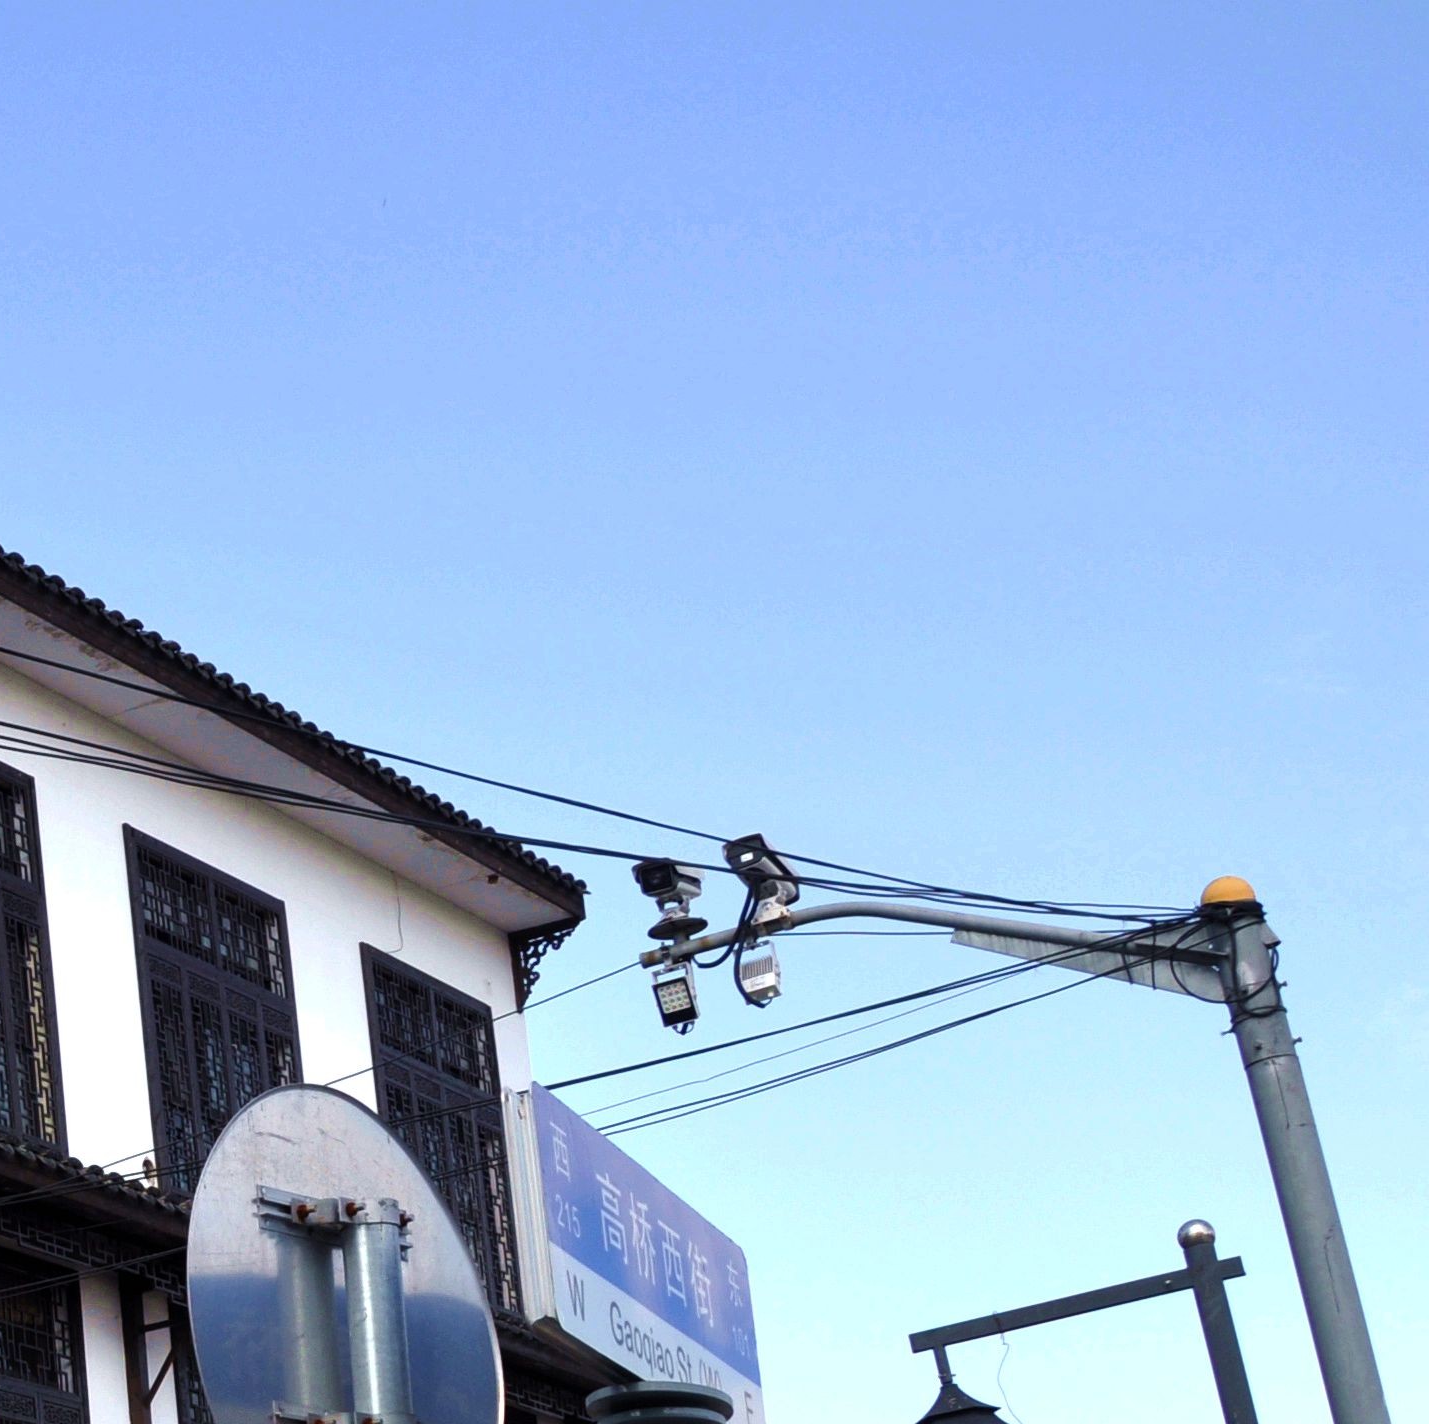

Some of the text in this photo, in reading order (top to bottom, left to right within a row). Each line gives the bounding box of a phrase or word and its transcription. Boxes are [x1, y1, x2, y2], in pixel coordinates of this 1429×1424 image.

[549, 1121, 571, 1182] 西
[555, 1194, 581, 1238] 215
[595, 1172, 714, 1328] 高桥西街
[566, 1269, 585, 1321] W
[725, 1260, 743, 1308] 东
[609, 1301, 674, 1379] Gaoqiao
